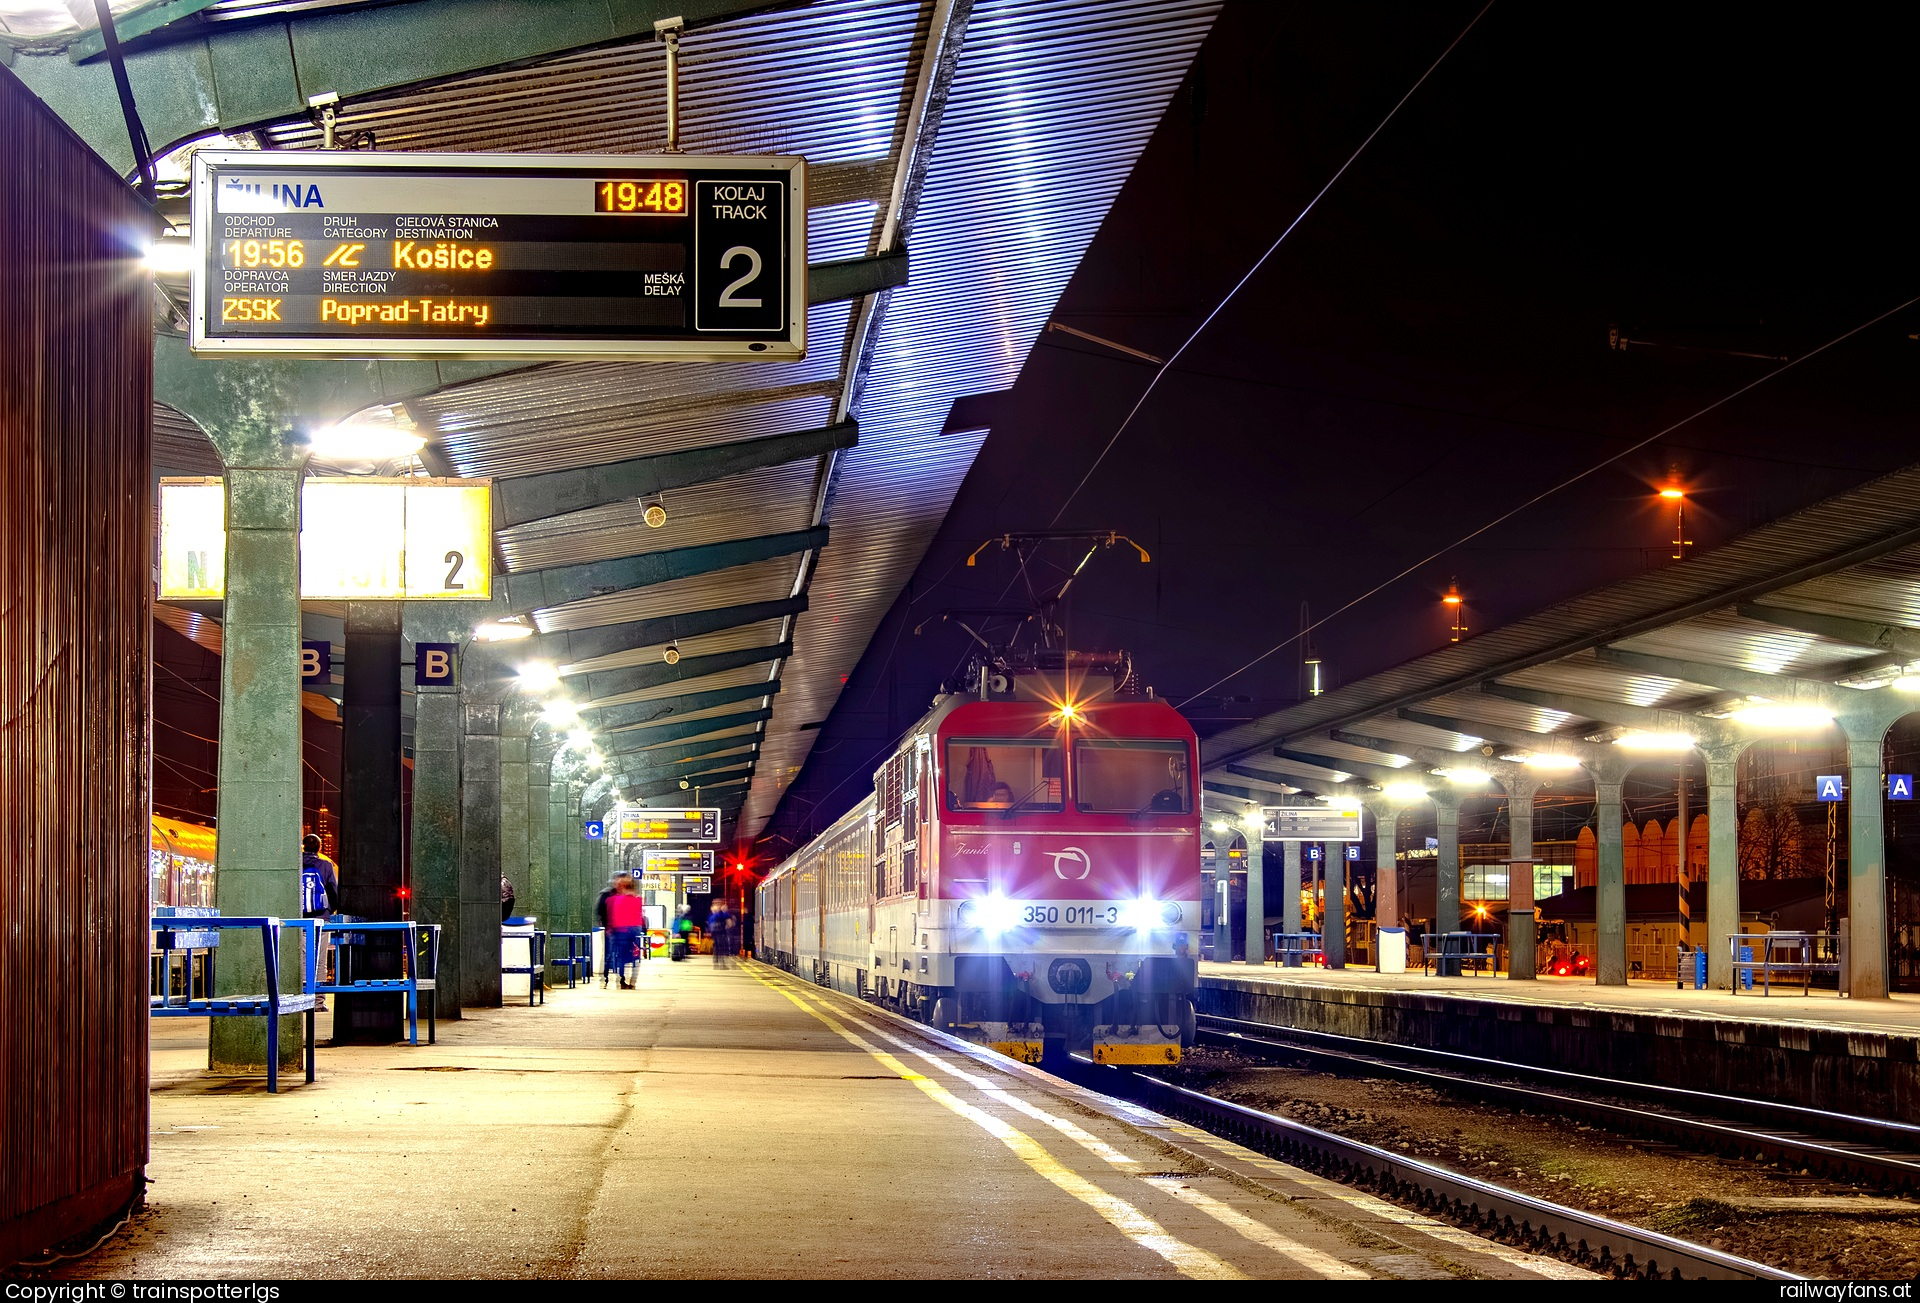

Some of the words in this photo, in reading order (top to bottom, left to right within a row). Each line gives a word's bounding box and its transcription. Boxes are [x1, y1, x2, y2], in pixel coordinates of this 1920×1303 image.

[226, 178, 324, 208] INA
[601, 182, 683, 211] 19:48
[714, 186, 766, 201] KOĽAJ
[712, 205, 767, 220] TRACK
[225, 216, 275, 226] ODCHOD
[323, 217, 357, 226] DRUH
[448, 217, 499, 228] STANICA
[225, 228, 292, 238] DEPARTURE
[323, 228, 388, 239] CATEGORY
[395, 229, 473, 239] DESTINATION
[229, 240, 304, 267] 19:56
[395, 241, 493, 269] Košice
[224, 271, 290, 281] DOPRAVCA
[323, 271, 357, 281] SMER
[359, 271, 397, 281] JAZDY
[644, 272, 685, 284] MEŠKÁ
[719, 246, 762, 308] 2
[224, 282, 290, 292] OPERATOR
[323, 283, 387, 293] DIRECTION
[644, 286, 682, 295] DELAY
[223, 298, 282, 321] ZSSK
[322, 299, 489, 326] Poprad-Tatry
[444, 550, 464, 589] 2
[301, 650, 322, 677] B
[425, 650, 450, 678] B
[1822, 780, 1838, 797] A
[1893, 778, 1909, 796] A
[588, 825, 599, 837] C
[704, 823, 714, 835] 2
[1267, 821, 1276, 832] 4
[1310, 849, 1319, 859] B
[1349, 848, 1358, 859] B
[703, 860, 710, 869] 2
[633, 870, 641, 878] D
[1024, 906, 1059, 923] 350
[1065, 907, 1118, 924] 011-3
